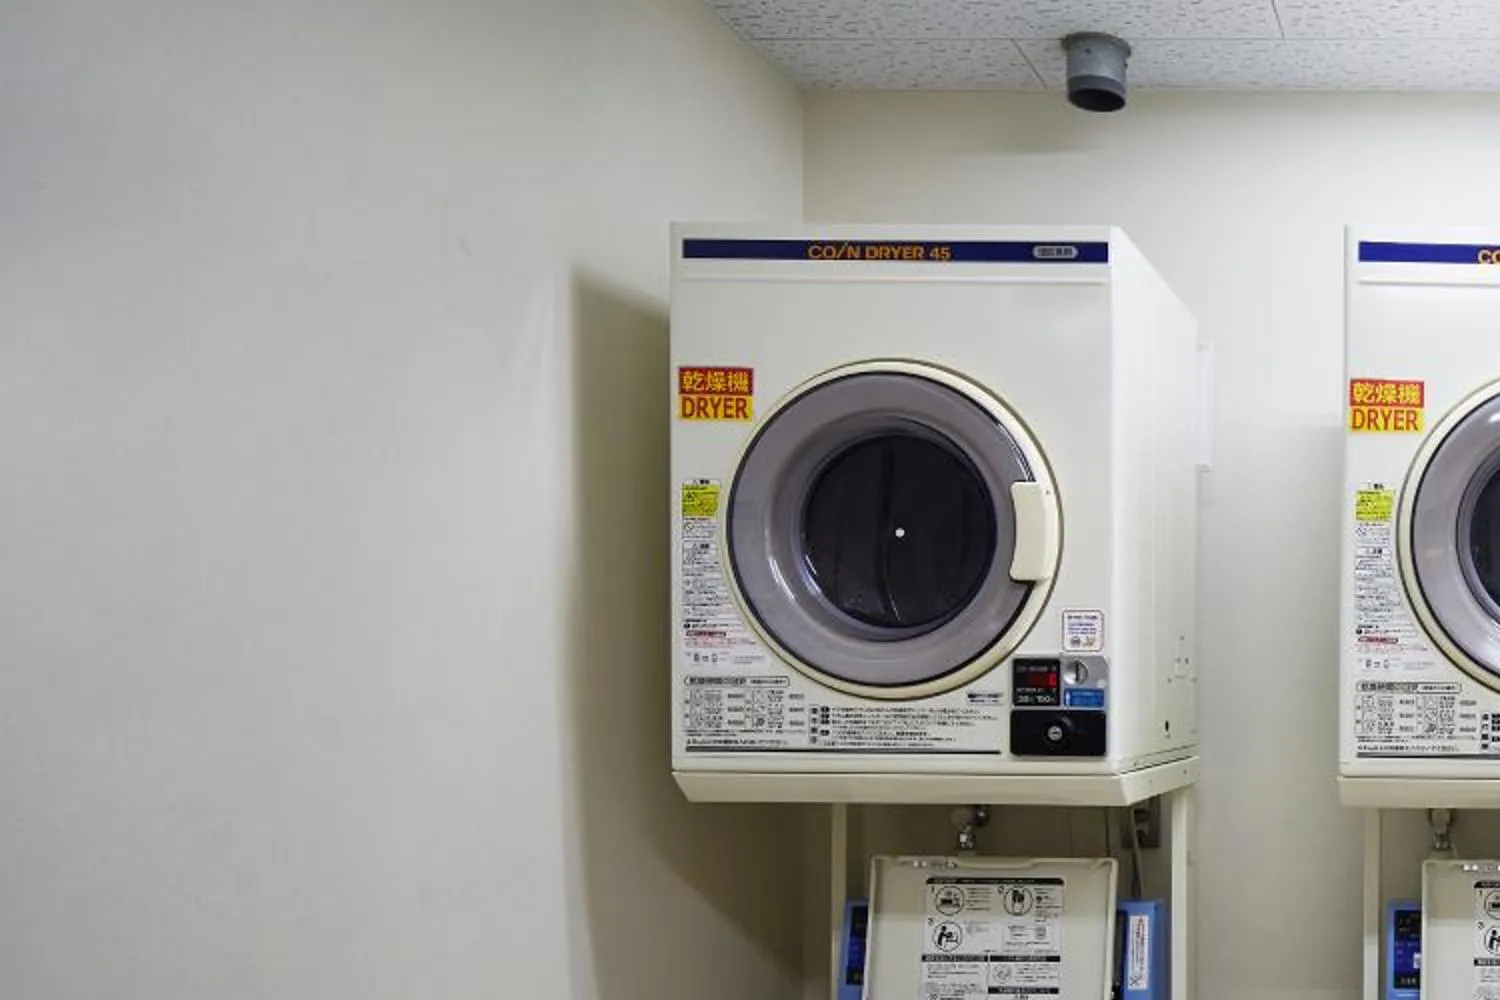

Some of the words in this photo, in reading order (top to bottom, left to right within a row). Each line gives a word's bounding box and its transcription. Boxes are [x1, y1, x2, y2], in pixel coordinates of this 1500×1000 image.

[865, 245, 924, 259] DRYER
[930, 246, 951, 259] 45
[682, 370, 748, 393] 乾燥機
[1353, 382, 1421, 405] 乾燥機
[681, 397, 749, 419] DRYER
[1352, 409, 1419, 431] DRYER
